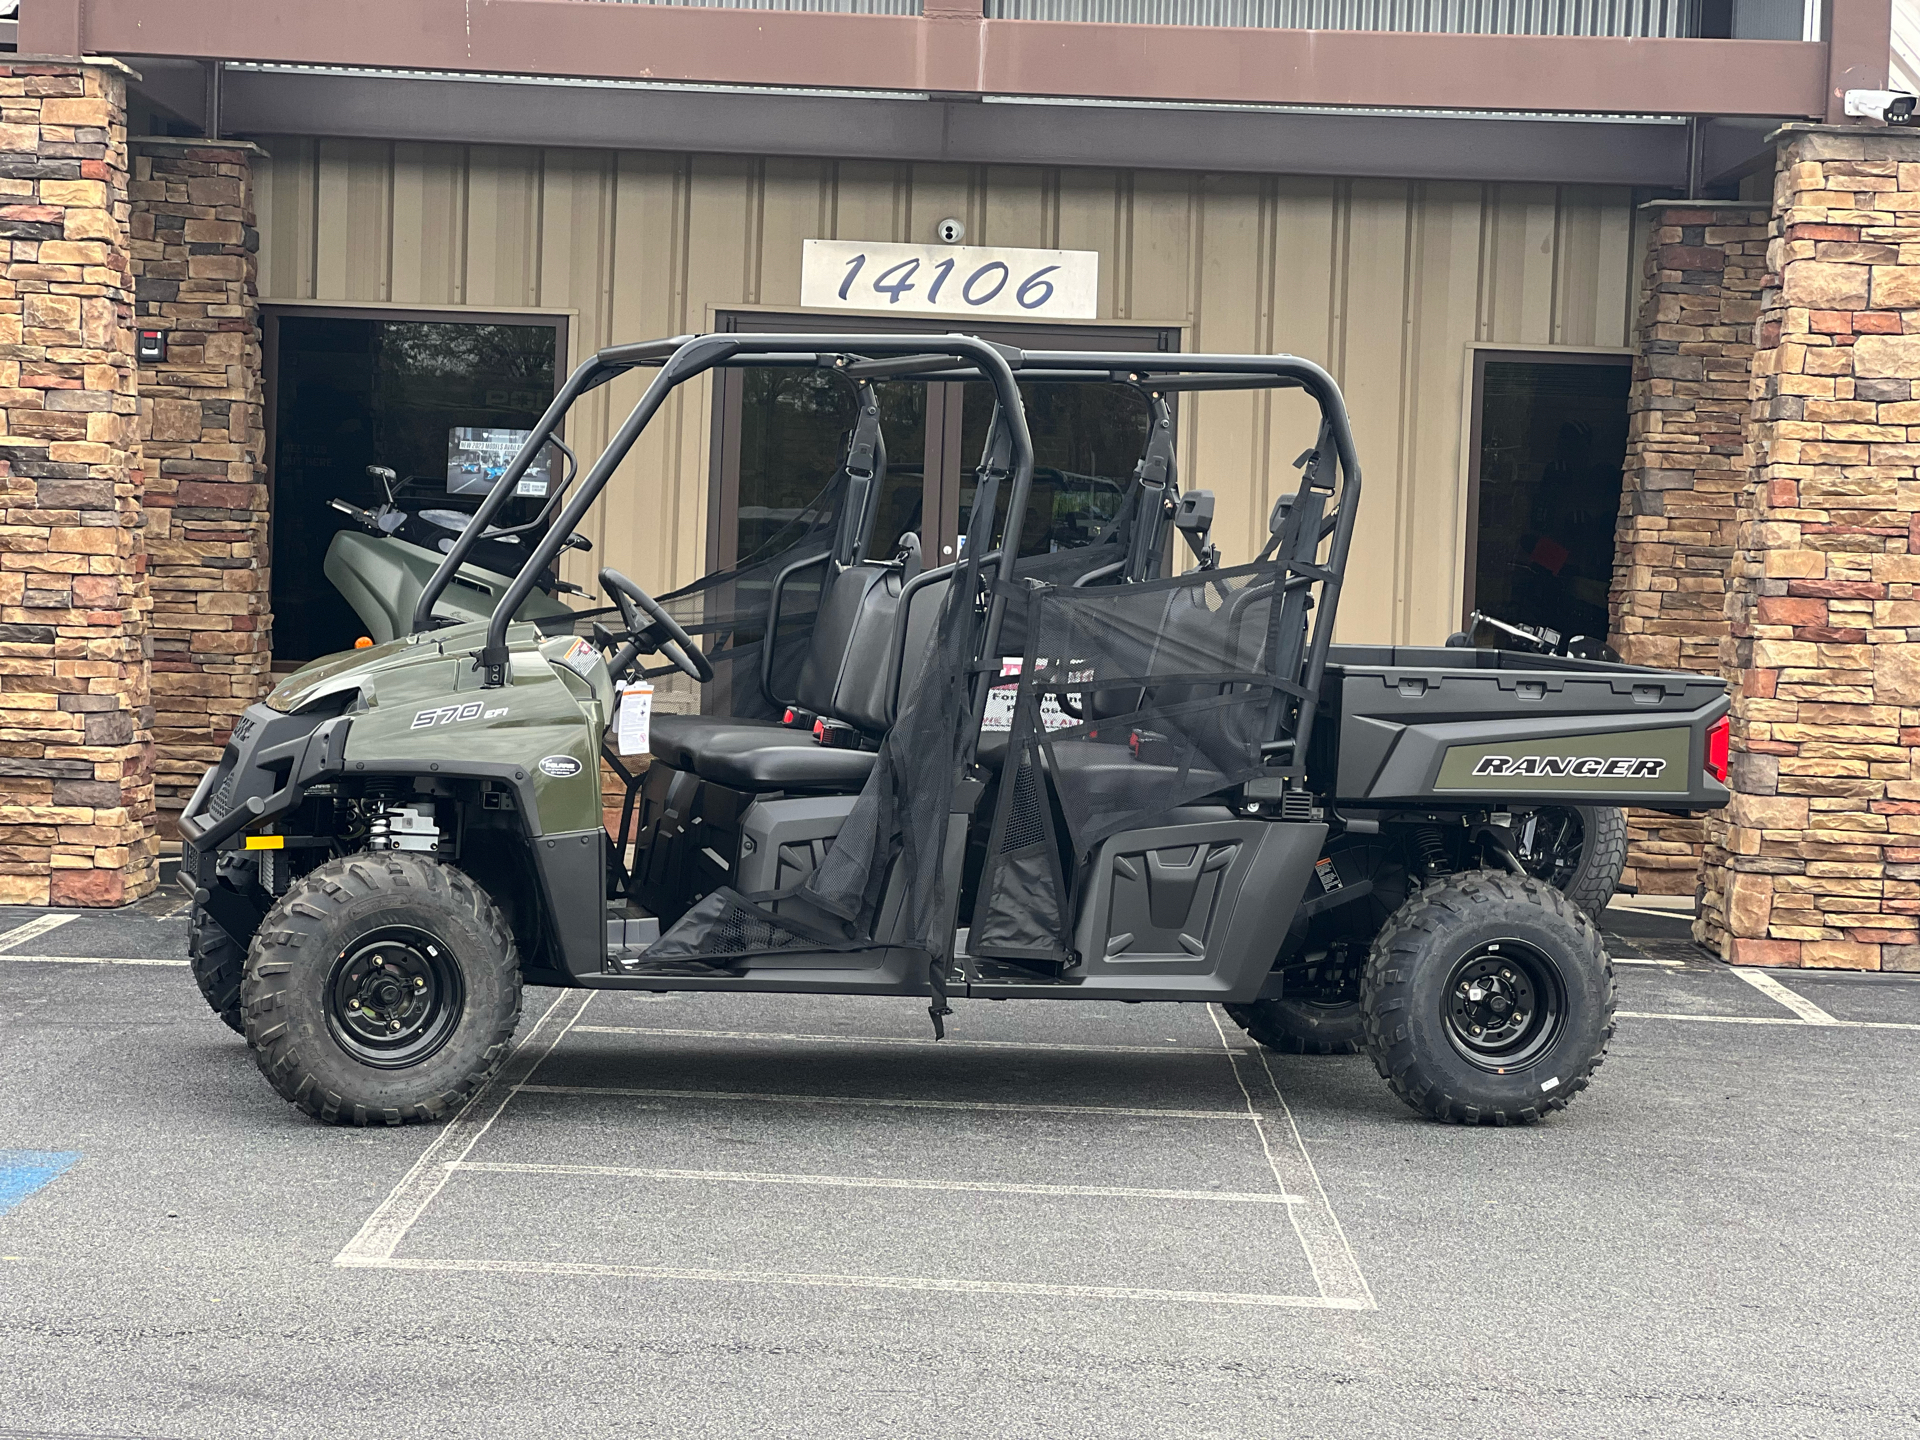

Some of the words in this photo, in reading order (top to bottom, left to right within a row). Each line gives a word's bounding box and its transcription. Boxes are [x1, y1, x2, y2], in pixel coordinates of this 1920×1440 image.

[838, 254, 1061, 309] 14106
[410, 701, 484, 729] 570
[484, 707, 509, 719] EFI
[1472, 756, 1666, 779] RANGER
